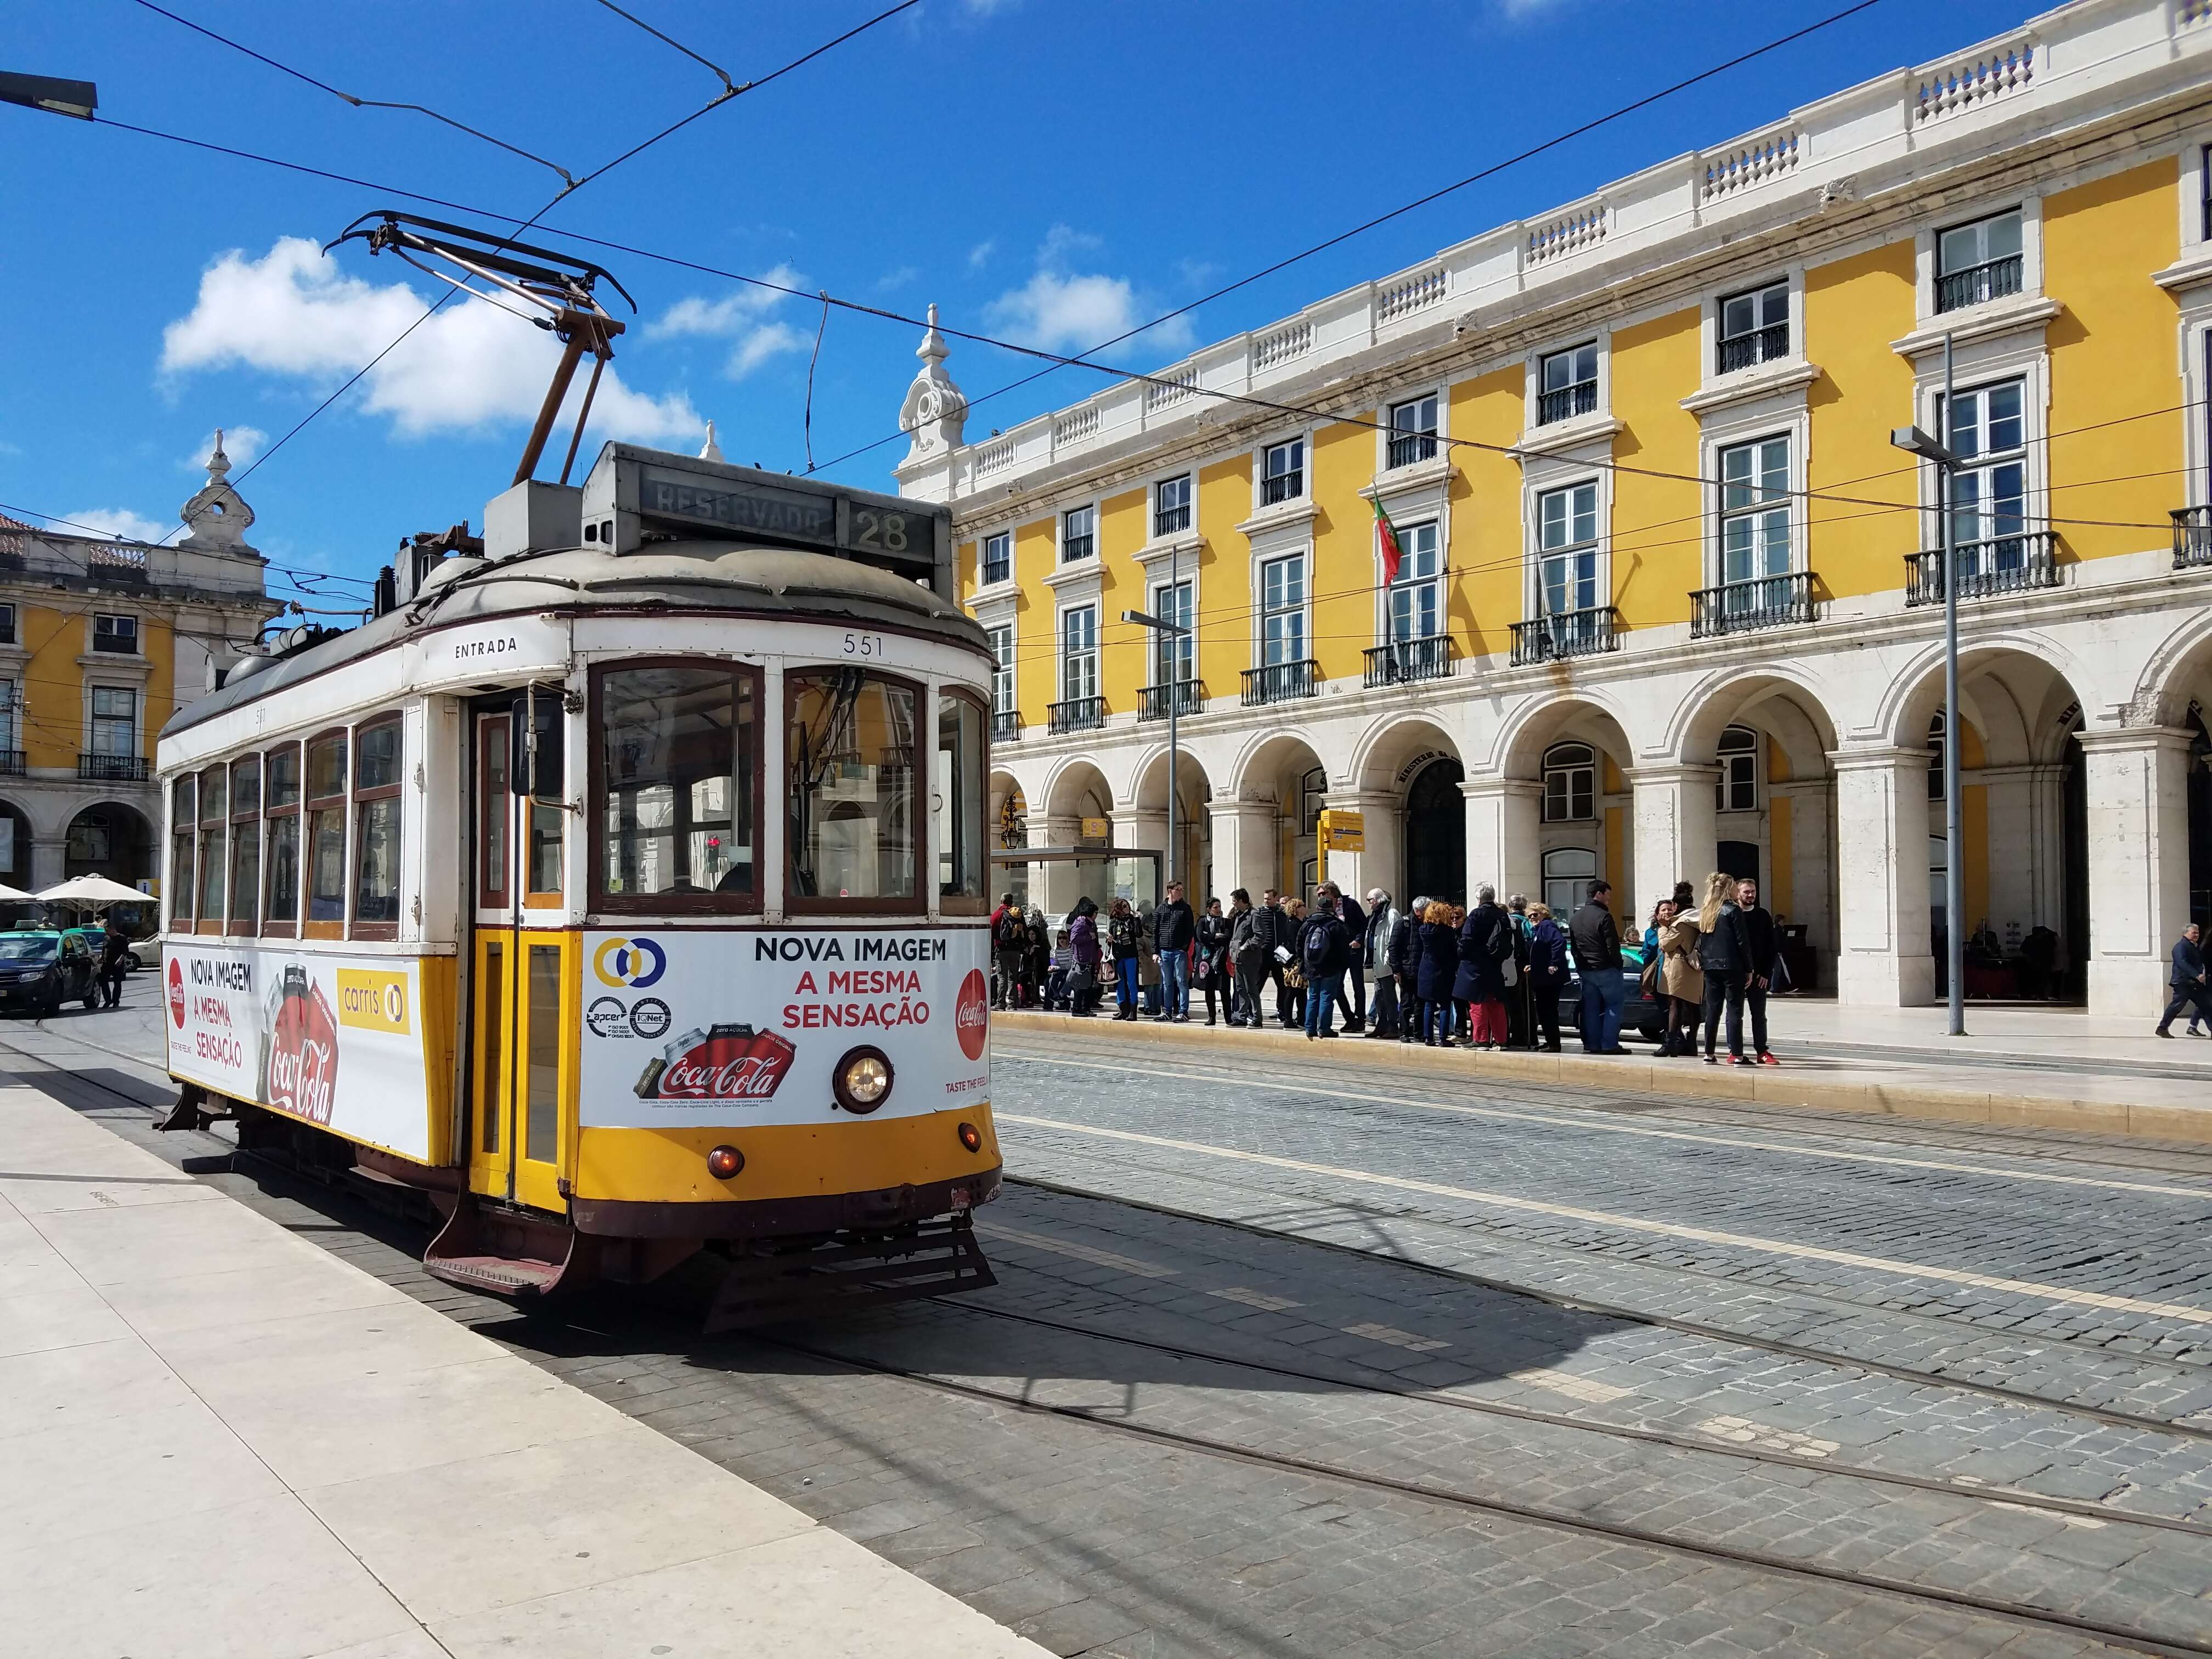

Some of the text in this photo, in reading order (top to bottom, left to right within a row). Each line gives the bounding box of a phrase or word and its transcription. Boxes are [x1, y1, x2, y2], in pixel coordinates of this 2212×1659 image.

[658, 483, 820, 535] RESERVADO
[856, 510, 907, 551] 28
[456, 637, 516, 659] ENTRADA
[844, 634, 881, 656] 551
[755, 938, 946, 961] NOVA IMAGEM
[191, 958, 251, 992] NOVA IMAGEM
[795, 970, 922, 995] A MESMA
[345, 979, 379, 1014] carris
[633, 998, 668, 1012] CERTIFIED
[194, 995, 201, 1022] A
[201, 996, 233, 1028] MESMA
[594, 1014, 620, 1023] apcer
[637, 1014, 663, 1023] IQNet
[782, 996, 930, 1030] SENSAÇÃO
[958, 1000, 986, 1029] Coca-Cola
[196, 1031, 242, 1069] SENSAÇÃO
[761, 1032, 793, 1053] SABOR ORIGINAL
[267, 1031, 330, 1122] Coca-Cola
[658, 1057, 782, 1096] Coca-Cola
[945, 1081, 966, 1093] TASTE
[967, 1078, 977, 1090] THE
